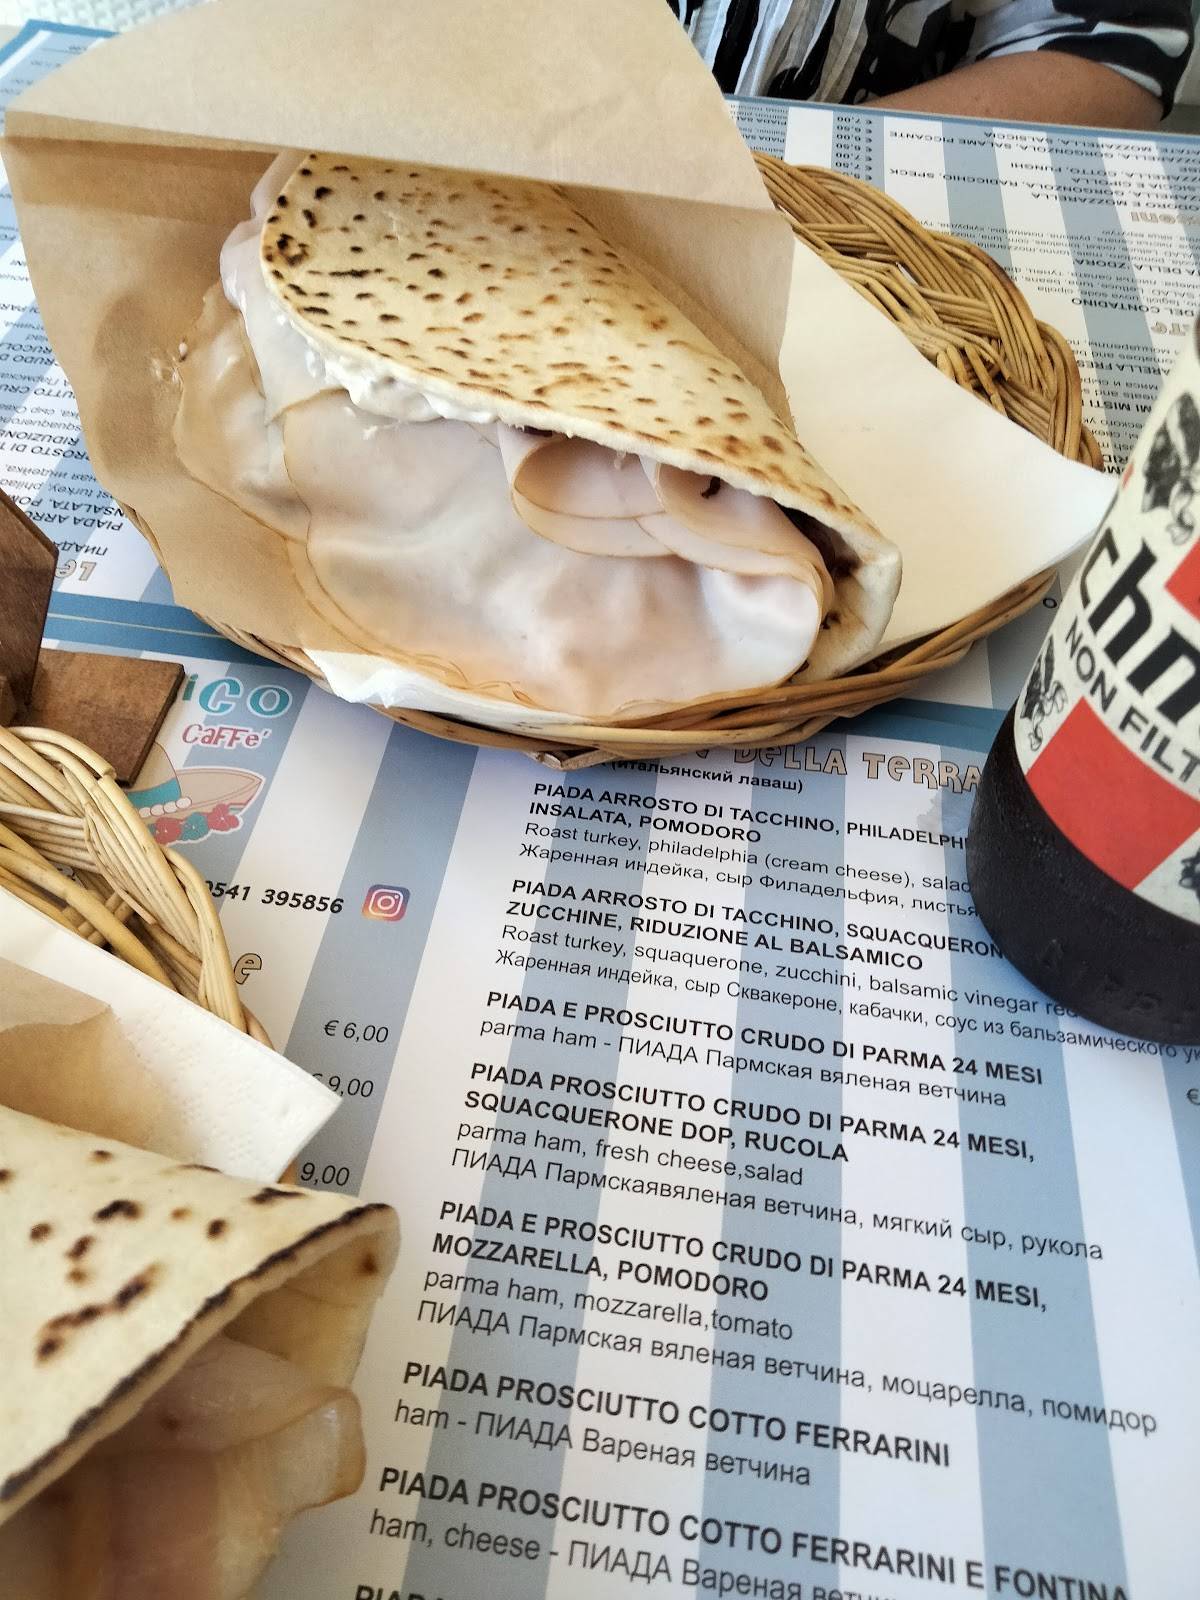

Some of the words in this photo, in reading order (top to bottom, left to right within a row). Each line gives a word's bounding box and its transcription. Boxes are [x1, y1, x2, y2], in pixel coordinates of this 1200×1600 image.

[889, 132, 954, 143] PICCANTE
[958, 139, 1011, 149] SALAME
[1010, 162, 1062, 173] FUNGHI
[889, 169, 935, 178] SPECK
[939, 173, 1018, 187] RADICCHIO,
[1022, 181, 1124, 196] GORGONZOLA,
[1031, 193, 1127, 206] MOZZARELLA
[1071, 178, 1132, 188] CIPOLLA
[1071, 298, 1160, 313] CONTADINO
[1090, 400, 1131, 411] MISTI
[49, 500, 124, 517] NSALATA,
[73, 516, 123, 531] PIADA
[1065, 615, 1117, 713] NON
[1118, 704, 1200, 785] FILT
[534, 783, 594, 803] PIADA
[597, 791, 698, 815] ARROSTO
[704, 804, 723, 818] DI
[730, 807, 839, 835] TACCHINO,
[737, 774, 804, 795] лаваш)
[530, 802, 631, 828] INSALATA,
[640, 815, 761, 843] POMODORO
[519, 843, 618, 868] Жаренная
[625, 859, 708, 882] индейка,
[716, 872, 752, 888] сыр
[760, 875, 904, 909] Филадельфия,
[912, 899, 978, 917] листья
[525, 823, 578, 840] Roast
[584, 829, 640, 851] turkey,
[649, 839, 759, 866] philadelphia
[763, 852, 829, 876] (cream
[836, 864, 914, 888] cheese),
[261, 889, 345, 914] 395856
[512, 880, 577, 901] PIADA
[581, 890, 688, 915] ARROSTO
[694, 903, 714, 918] DI
[721, 906, 839, 938] TACCHINO,
[506, 901, 622, 932] ZUCCHINE,
[630, 916, 748, 946] RIDUZIONE
[754, 934, 783, 951] AL
[790, 938, 922, 970] BALSAMICO
[502, 924, 559, 946] Roast
[565, 933, 626, 958] turkey,
[634, 945, 767, 978] squaquerone,
[776, 965, 861, 991] zucchini,
[870, 975, 958, 1001] balsamic
[964, 990, 1038, 1014] vinegar
[324, 1020, 340, 1037] €
[343, 1022, 389, 1043] 6,00
[495, 949, 591, 976] Жаренная
[597, 966, 677, 991] индейка,
[685, 979, 720, 998] сыр
[727, 981, 841, 1015] Сквакероне,
[849, 1001, 928, 1027] кабачки,
[935, 1015, 977, 1033] соус
[984, 1021, 1004, 1035] из
[1010, 1021, 1176, 1057] бальзамического
[480, 1021, 545, 1041] parma
[553, 1026, 596, 1048] ham
[619, 1036, 698, 1064] ПИАДА
[706, 1048, 812, 1081] Пармская
[821, 1069, 910, 1093] вяленая
[919, 1083, 1006, 1107] ветчина
[487, 991, 556, 1016] PIADA
[563, 1001, 578, 1019] E
[585, 1004, 733, 1041] PROSCIUTTO
[741, 1028, 825, 1055] CRUDO
[833, 1040, 854, 1059] DI
[863, 1045, 946, 1071] PARMA
[952, 1057, 978, 1075] 24
[985, 1061, 1042, 1085] MESI
[328, 1075, 374, 1098] 9,00
[471, 1062, 543, 1089] PIADA
[550, 1074, 705, 1112] PROSCIUTTO
[713, 1098, 800, 1126] CRUDO
[809, 1111, 831, 1131] DI
[840, 1115, 927, 1144] PARMA
[933, 1129, 960, 1148] 24
[968, 1133, 1033, 1163] MESI,
[457, 1122, 526, 1146] parma
[534, 1130, 585, 1158] ham,
[596, 1139, 648, 1164] fresh
[658, 1149, 803, 1186] cheese,salad
[465, 1091, 673, 1137] SQUACQUERONE
[681, 1121, 736, 1150] DOP,
[745, 1130, 849, 1162] RUCOLA
[300, 1162, 350, 1187] 9,00
[452, 1148, 537, 1180] ПИАДА
[545, 1162, 755, 1209] Пармскаявяленая
[764, 1198, 863, 1229] ветчина,
[873, 1214, 952, 1239] мягкий
[961, 1226, 1012, 1250] сыр,
[1022, 1235, 1103, 1260] рукола
[432, 1232, 608, 1281] MOZZARELLA,
[618, 1260, 768, 1301] POMODORO
[440, 1201, 514, 1231] PIADA
[521, 1213, 538, 1234] E
[544, 1216, 704, 1258] PROSCIUTTO
[711, 1241, 802, 1273] CRUDO
[810, 1255, 833, 1277] DI
[842, 1260, 931, 1291] PARMA
[938, 1274, 967, 1297] 24
[975, 1279, 1046, 1312] MESI,
[424, 1271, 499, 1296] parma
[507, 1278, 563, 1309] ham,
[574, 1293, 792, 1340] mozzarella,tomato
[417, 1300, 510, 1336] ПИАДА
[519, 1315, 642, 1353] Пармская
[651, 1340, 755, 1371] вяленая
[765, 1357, 872, 1392] ветчина,
[883, 1375, 1032, 1417] моцарелла,
[1043, 1399, 1156, 1437] помидор
[394, 1399, 449, 1429] ham
[475, 1411, 573, 1451] ПИАДА
[582, 1428, 695, 1468] Вареная
[705, 1453, 810, 1485] ветчина
[403, 1362, 488, 1396] PIADA
[496, 1376, 680, 1425] PROSCIUTTO
[688, 1405, 786, 1441] COTTO
[796, 1421, 949, 1467] FERRARINI
[370, 1508, 432, 1547] ham,
[445, 1523, 540, 1560] cheese
[568, 1540, 672, 1584] ПИАДА
[682, 1558, 801, 1600] Вареная
[379, 1467, 469, 1506] PIADA
[477, 1482, 671, 1537] PROSCIUTTO
[680, 1515, 782, 1554] COTTO
[792, 1532, 954, 1584] FERRARINI
[966, 1560, 984, 1589] E
